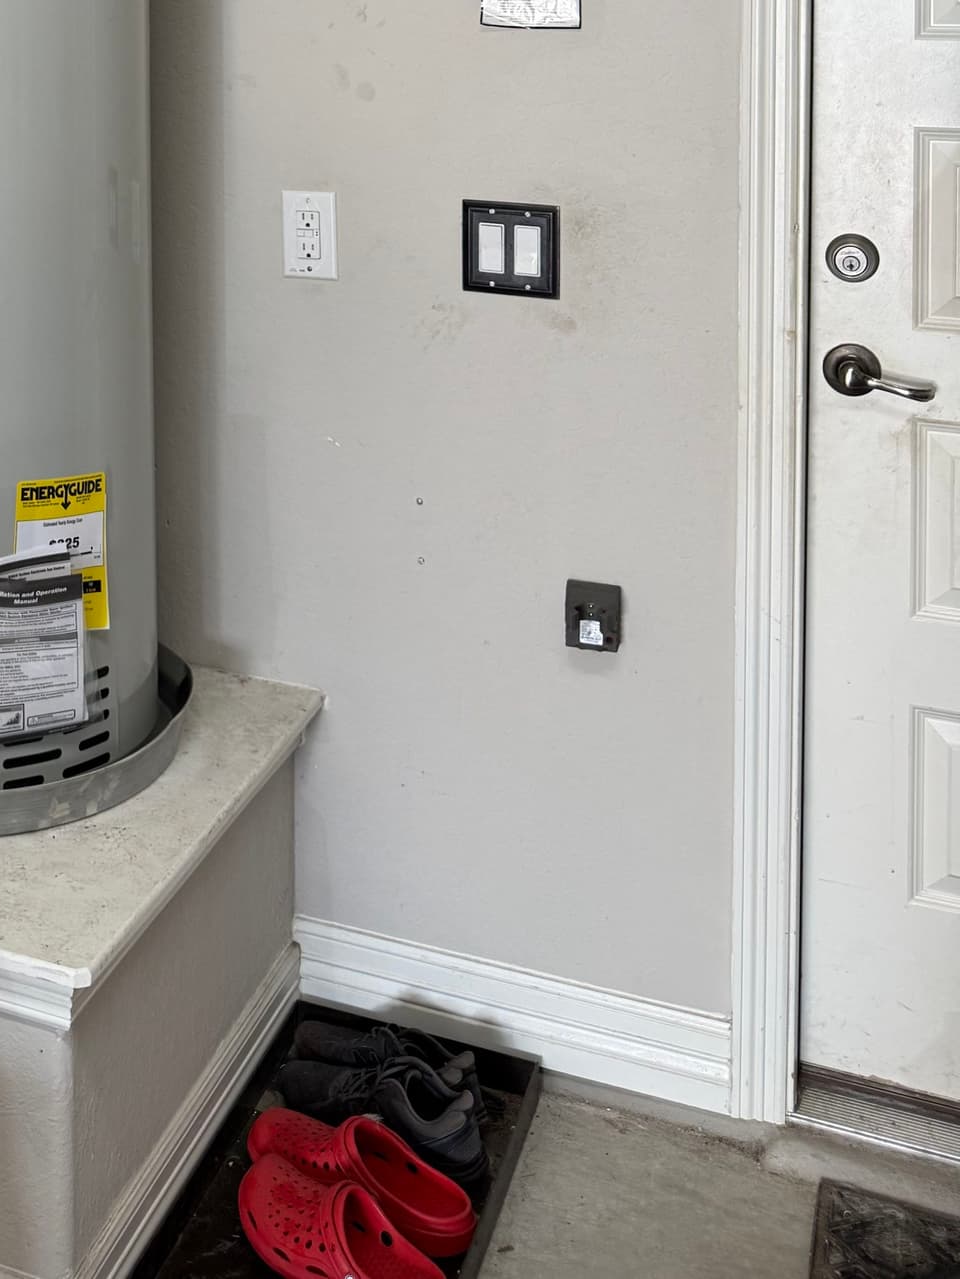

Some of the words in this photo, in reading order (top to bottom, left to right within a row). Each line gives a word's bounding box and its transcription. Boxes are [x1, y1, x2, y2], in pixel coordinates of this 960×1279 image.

[21, 478, 102, 503] ENERGYGUIDE
[21, 590, 35, 598] and
[35, 587, 68, 597] Operation
[13, 597, 39, 605] Manual
